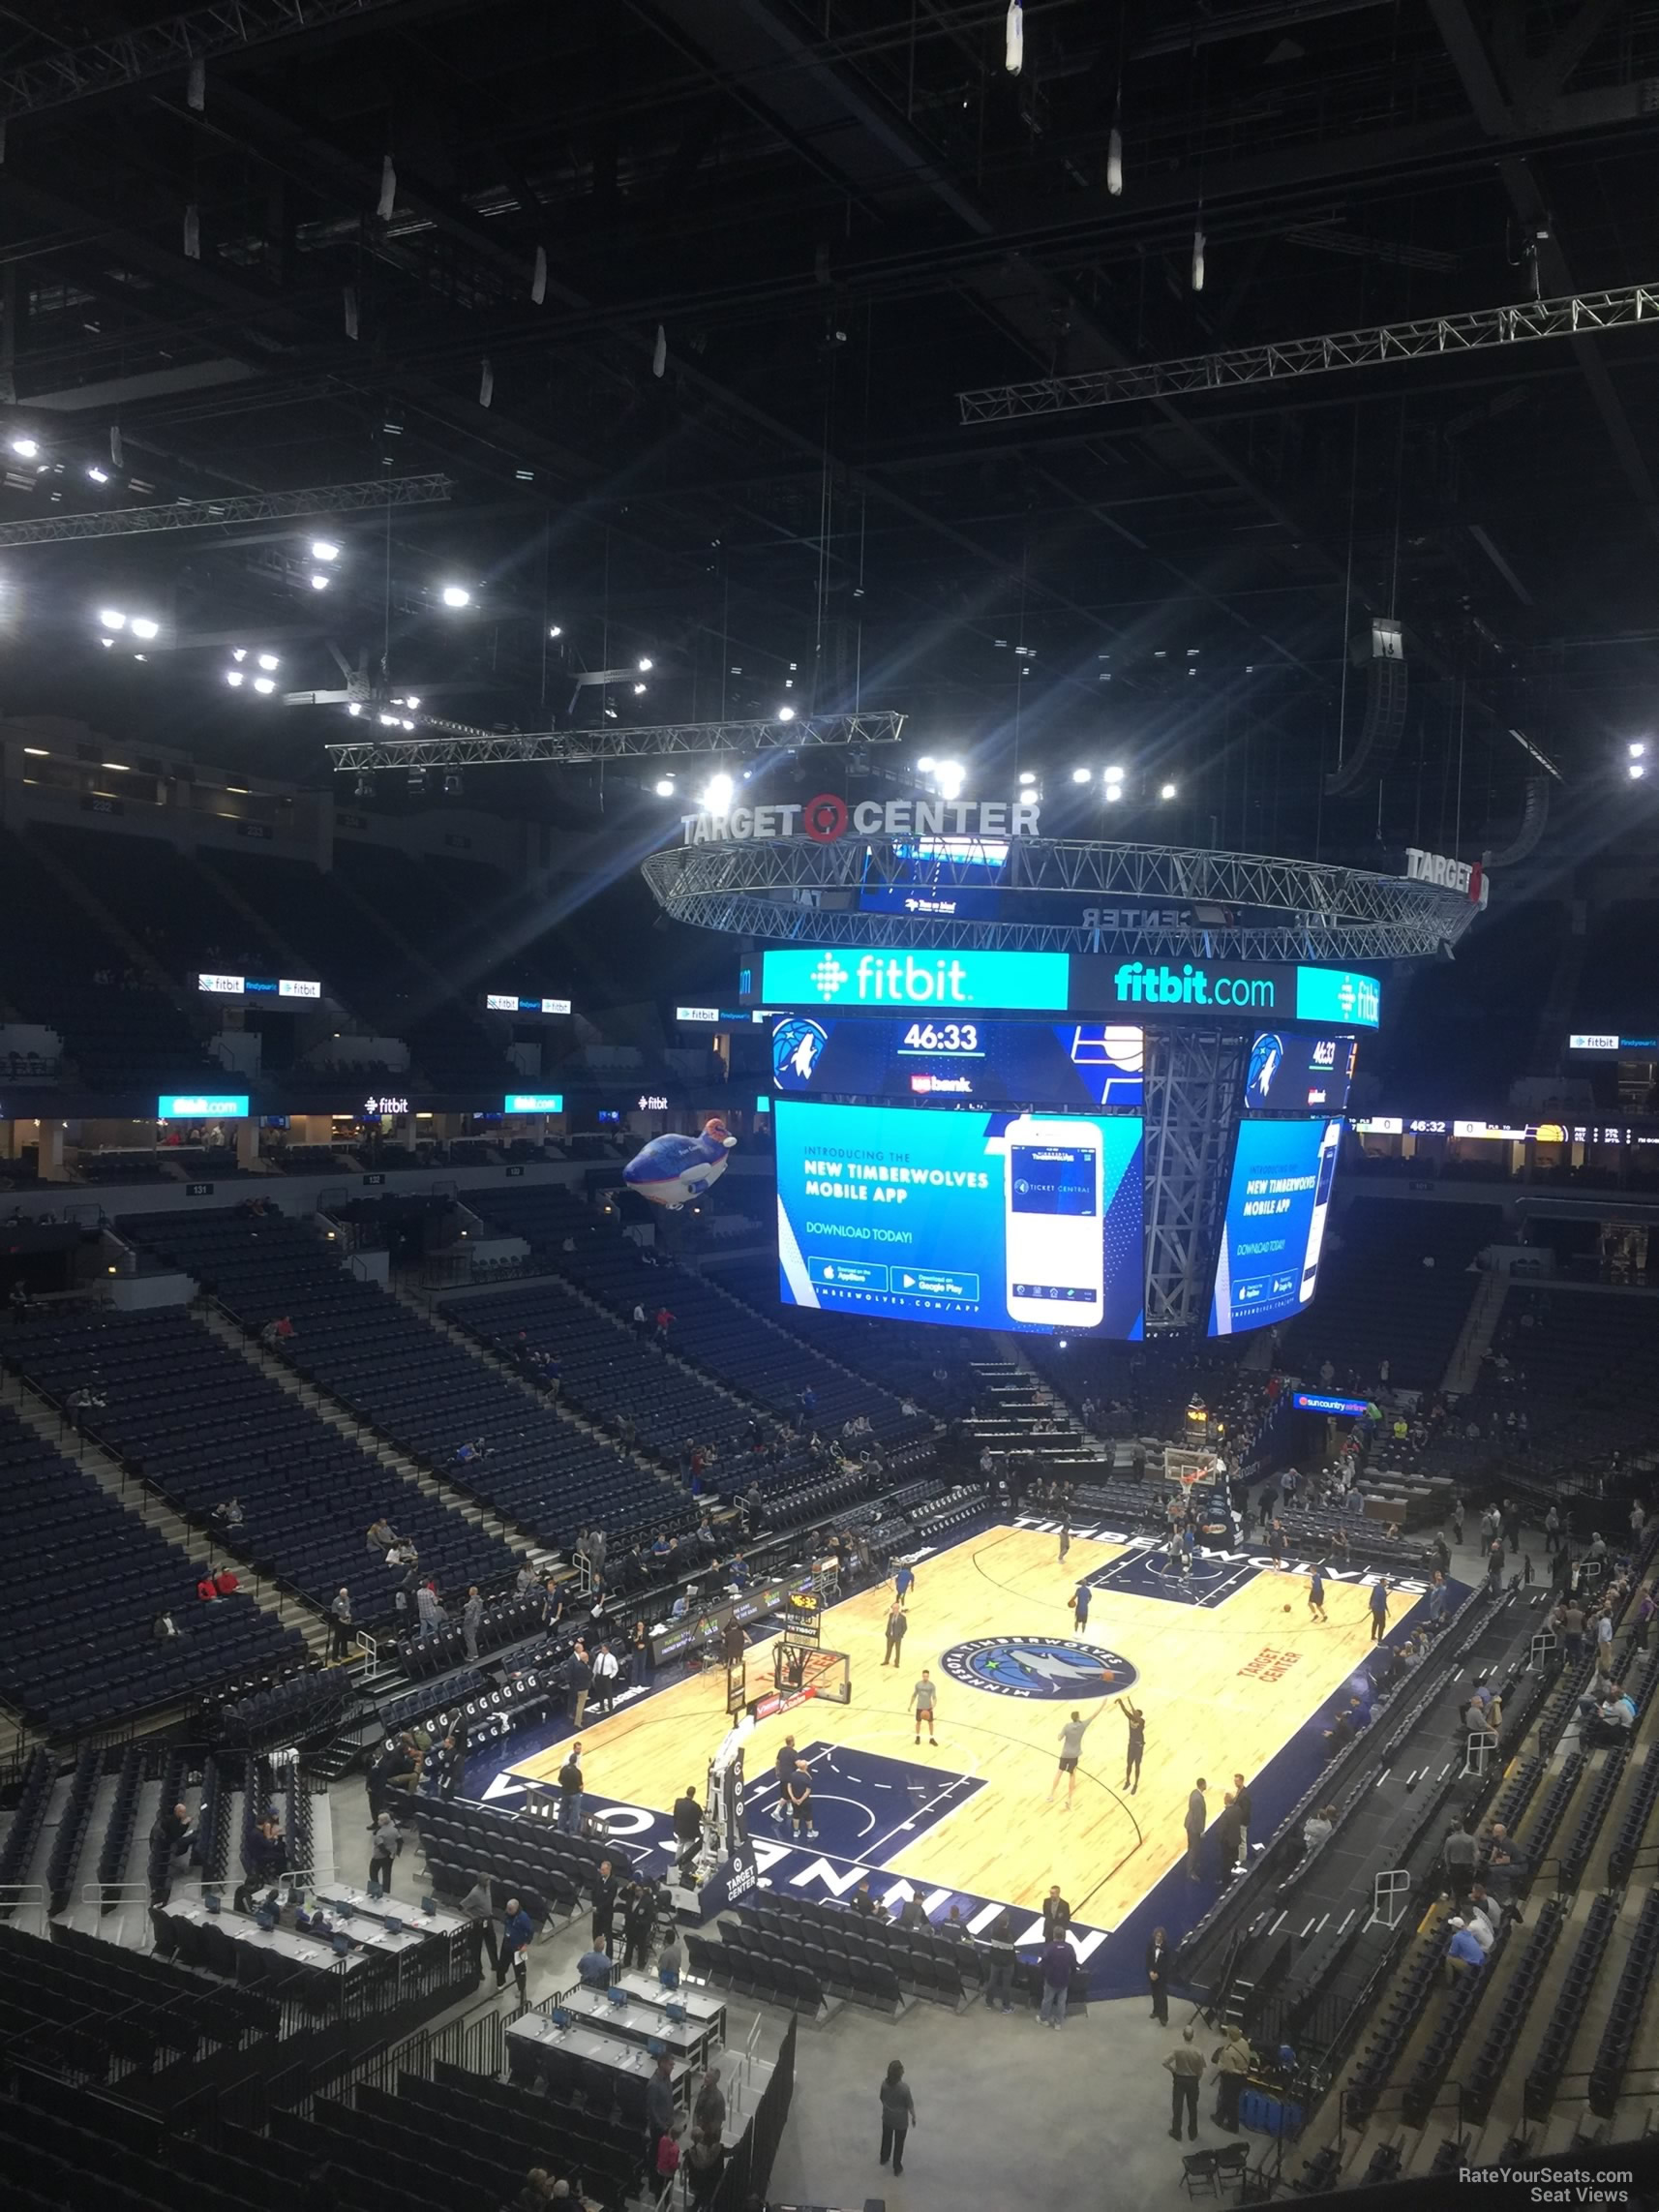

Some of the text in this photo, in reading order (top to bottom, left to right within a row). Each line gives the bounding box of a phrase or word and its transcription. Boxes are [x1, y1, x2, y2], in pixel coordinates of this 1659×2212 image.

[680, 800, 1041, 846] TARGET CENTER
[1405, 847, 1472, 894] TARGET
[215, 977, 240, 991] fitbit
[857, 954, 968, 1001] fitbit
[1114, 961, 1275, 1008] fitbit.com
[293, 983, 316, 996] fitbit
[692, 1010, 714, 1019] fitbit
[904, 1023, 978, 1050] 46:33
[1587, 1037, 1614, 1047] fitbit
[378, 1098, 408, 1114] fitbit
[648, 1097, 668, 1110] fitbit
[1410, 1120, 1446, 1133] 46:32
[804, 1146, 911, 1163] INTRODUCING THE
[804, 1160, 989, 1189] NEW TIMBERWOLVES
[194, 1185, 207, 1195] 131
[805, 1181, 908, 1204] MOBILE APP
[1247, 1180, 1267, 1195] NEW
[1243, 1198, 1291, 1217] MOBILE APP
[806, 1221, 913, 1244] DOWNLOAD TODAY!
[960, 1637, 1123, 1665] TIMBERWOLVES
[1236, 1647, 1282, 1678] TARGET
[1258, 1651, 1304, 1682] CENTER
[528, 1676, 536, 1687] G
[947, 1652, 1031, 1697] MINNESOTA
[503, 1685, 512, 1698] G
[516, 1681, 525, 1692] G
[479, 1697, 488, 1710] G
[491, 1691, 500, 1704] G
[467, 1703, 475, 1714] G
[426, 1720, 436, 1732] G
[439, 1713, 448, 1726] G
[385, 1739, 395, 1751] G
[726, 1864, 755, 1891] TARGET
[728, 1876, 756, 1902] CENTER
